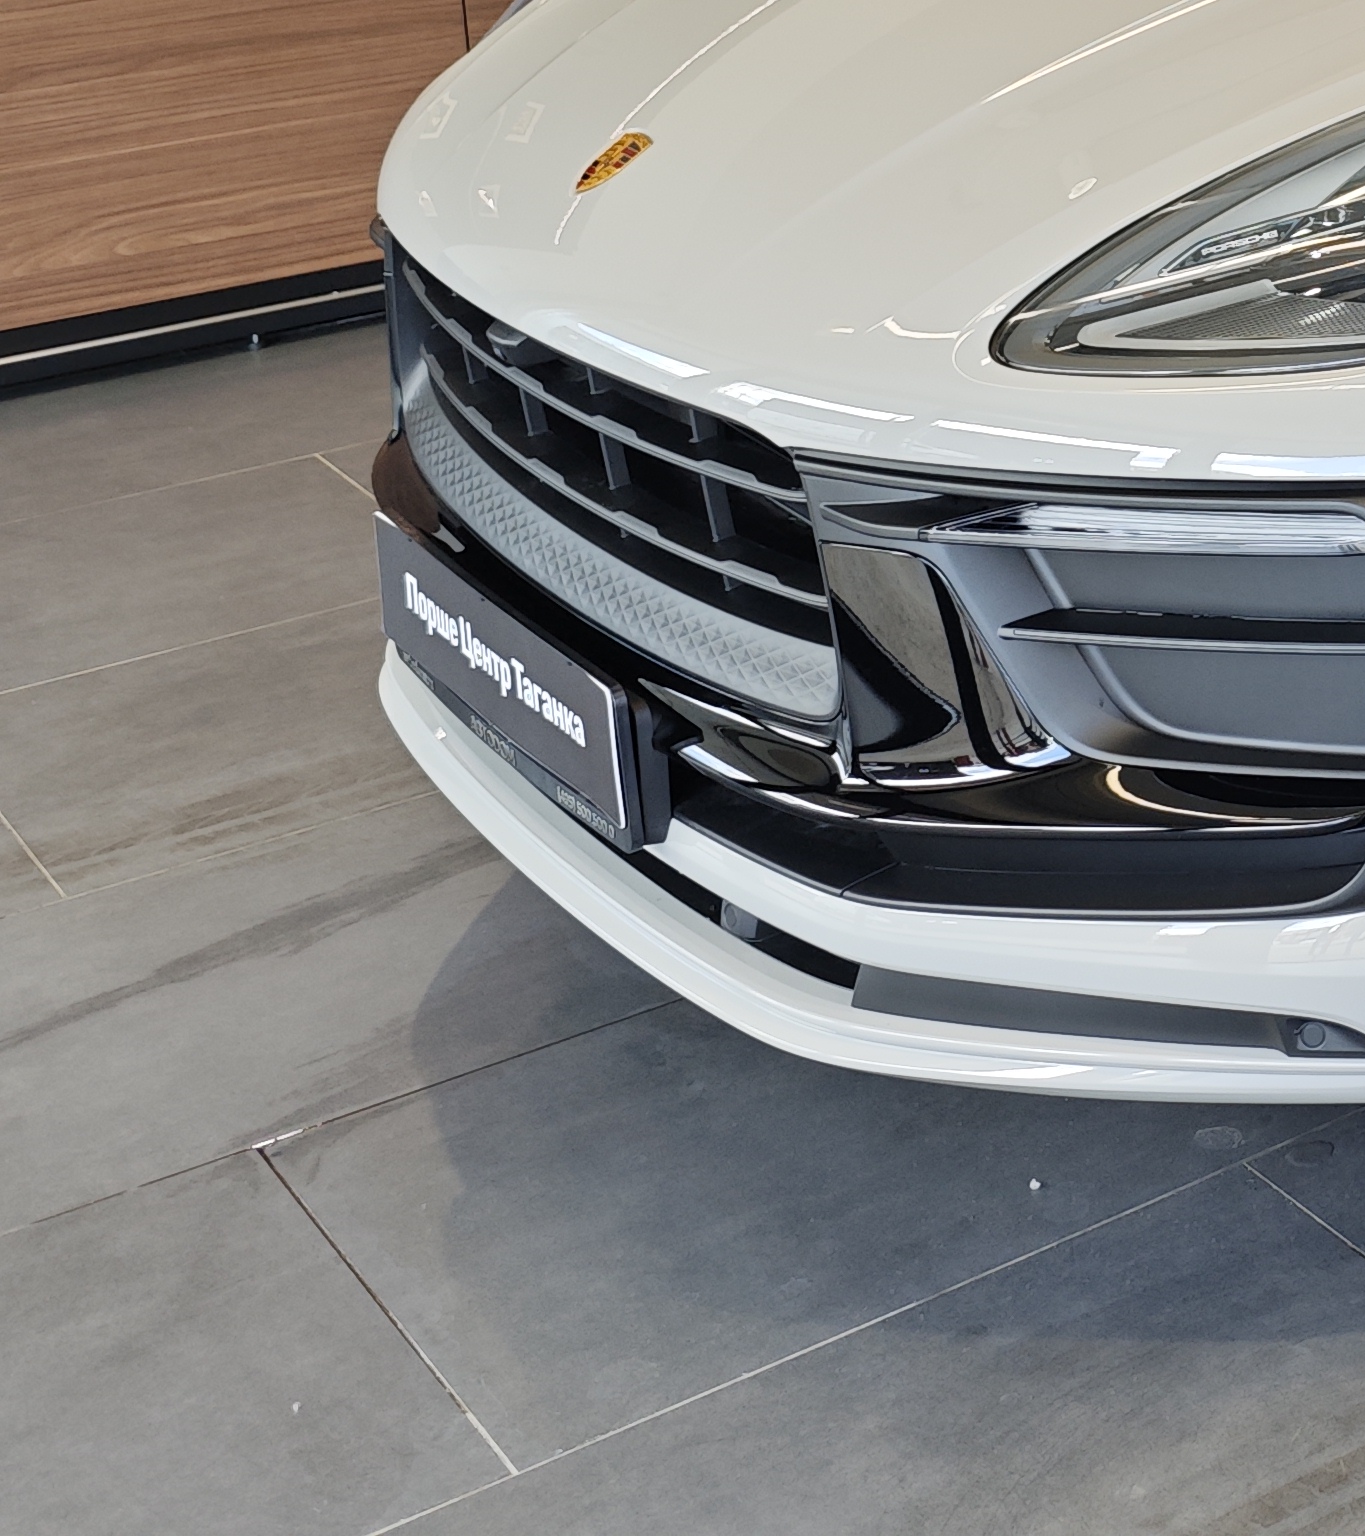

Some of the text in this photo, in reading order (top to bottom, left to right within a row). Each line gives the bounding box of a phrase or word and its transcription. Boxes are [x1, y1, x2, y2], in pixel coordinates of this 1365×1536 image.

[1201, 229, 1279, 256] PORSCHE
[404, 571, 460, 649] Порше
[458, 615, 513, 698] Центр
[510, 657, 587, 749] Таганка
